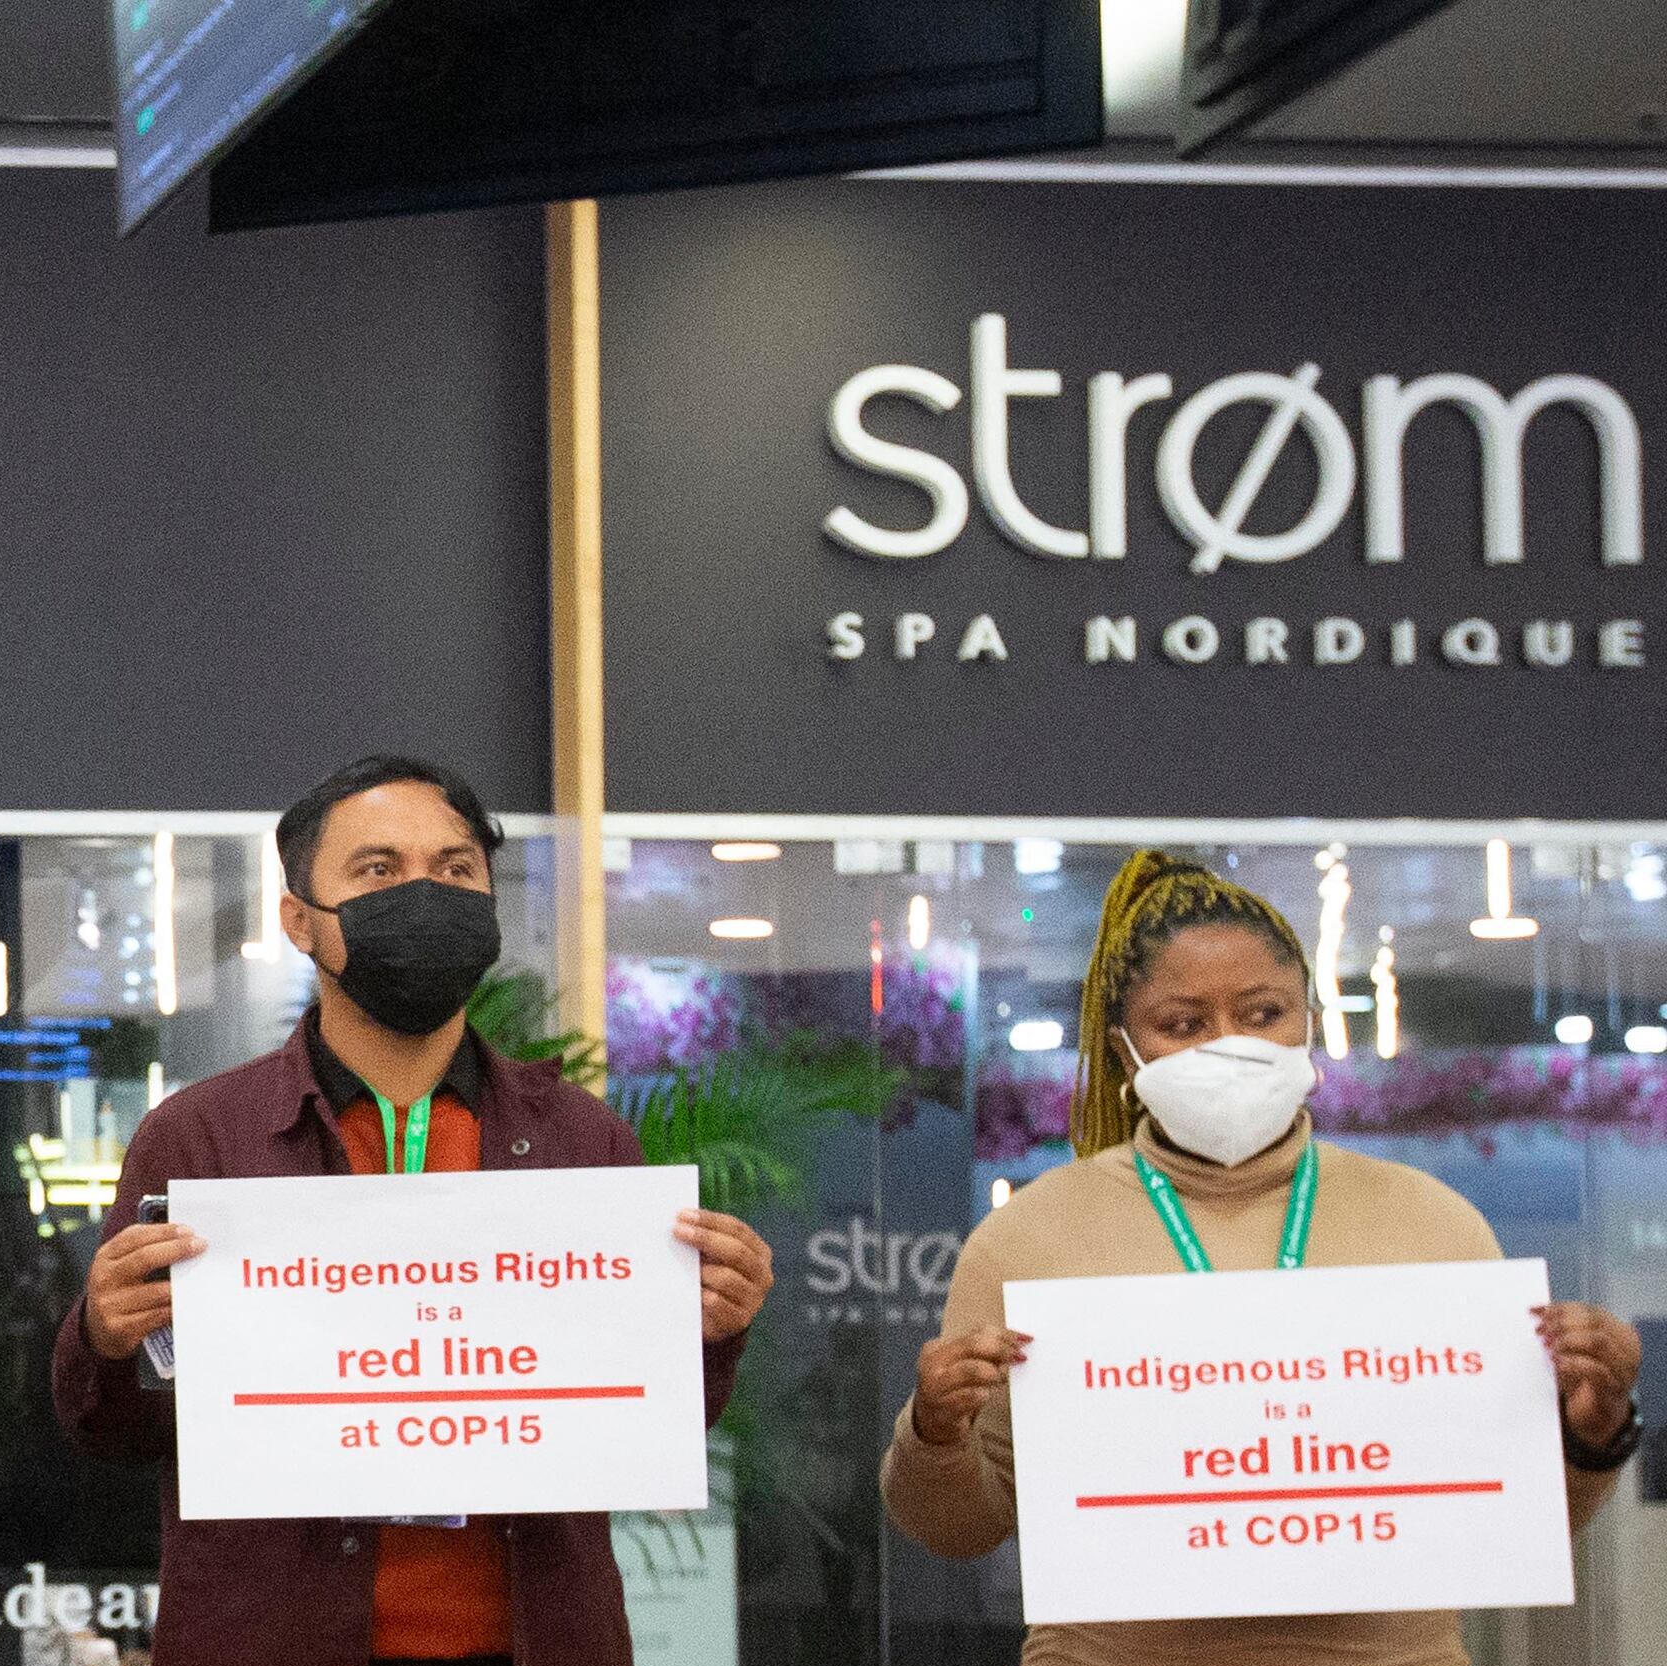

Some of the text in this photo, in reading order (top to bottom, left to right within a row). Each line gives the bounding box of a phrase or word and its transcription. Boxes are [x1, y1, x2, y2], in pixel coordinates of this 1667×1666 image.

[827, 314, 1640, 571] strøm
[831, 613, 1637, 663] SPA NORDIQUE
[242, 1250, 632, 1295] Indigenous Rights
[416, 1302, 464, 1321] is a
[337, 1336, 539, 1379] red line
[1083, 1346, 1484, 1393] Indigenous Rights
[340, 1414, 543, 1449] at COP15
[1264, 1400, 1313, 1419] is a
[1182, 1433, 1392, 1480] red line
[1187, 1511, 1398, 1550] at COP15
